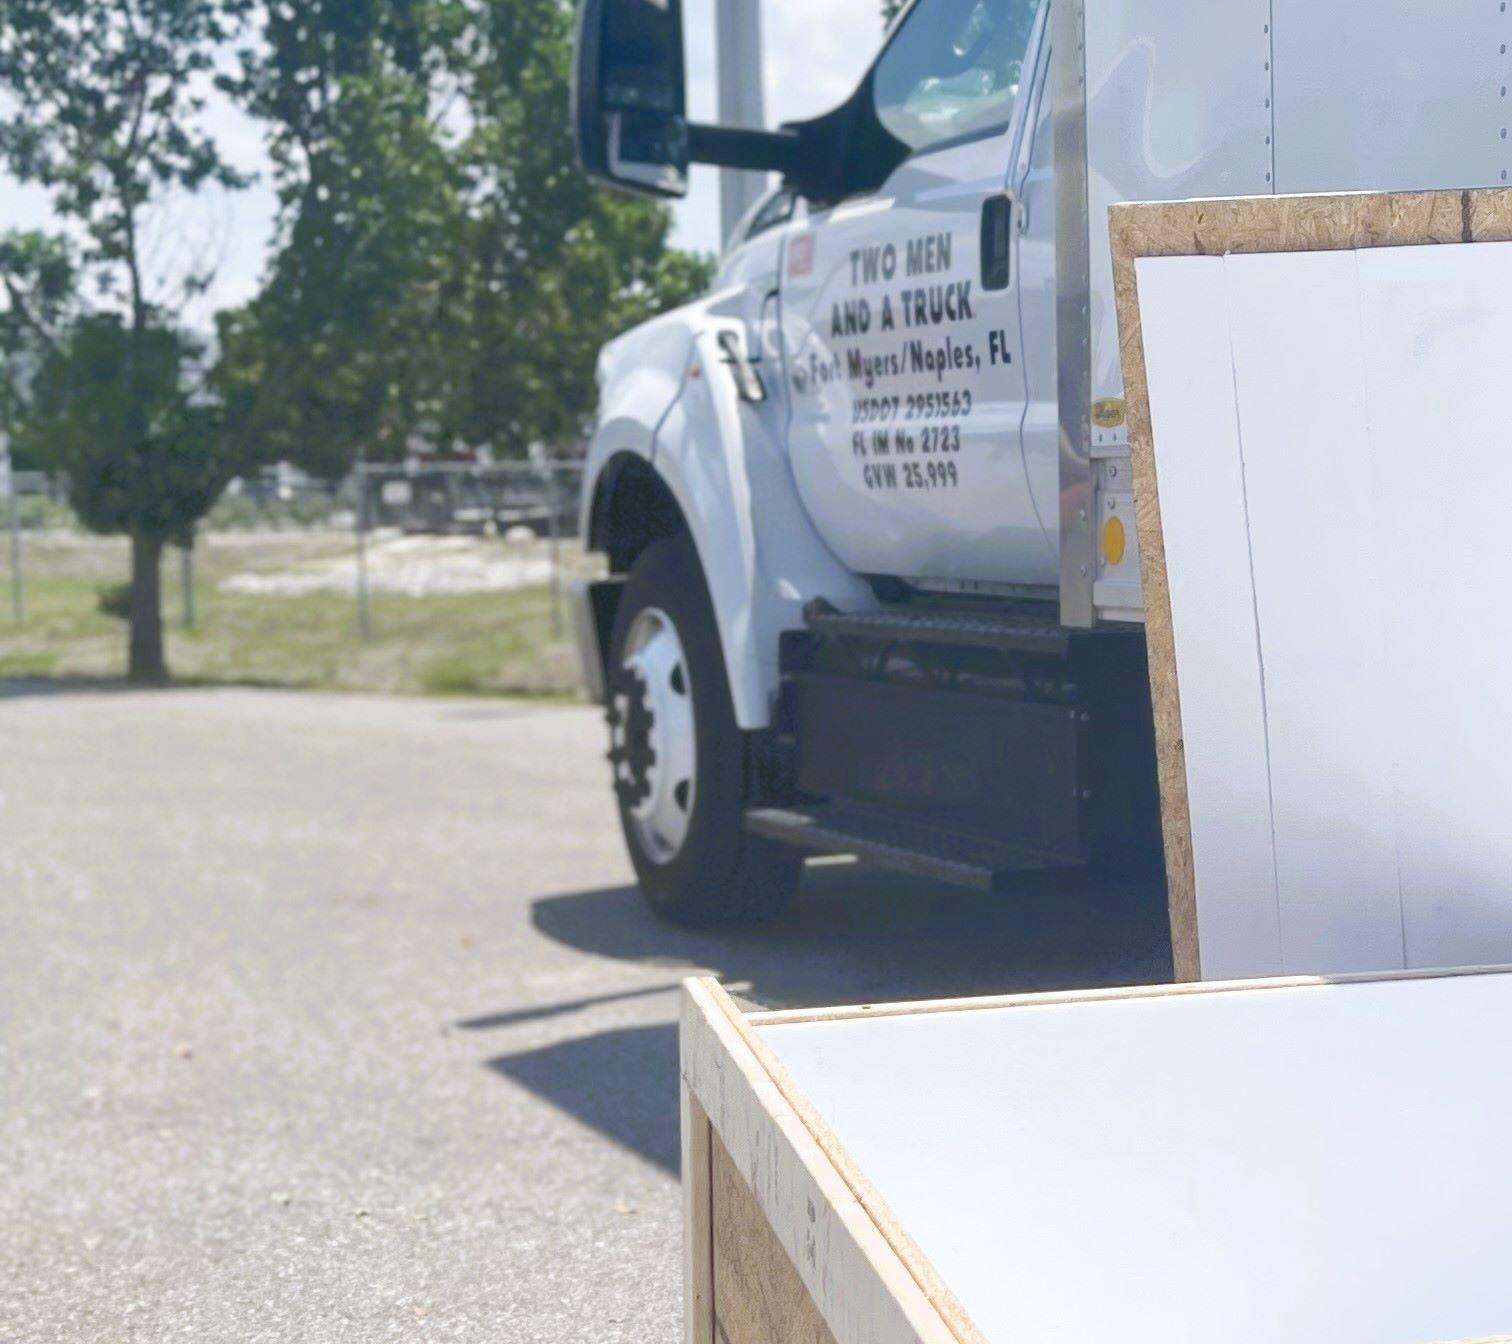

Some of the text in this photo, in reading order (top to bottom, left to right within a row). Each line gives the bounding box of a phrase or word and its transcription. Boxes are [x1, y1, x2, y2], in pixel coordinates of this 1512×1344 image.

[850, 231, 952, 287] TWO MEN
[831, 279, 973, 338] AND A TRUCK
[811, 346, 842, 385] Fort
[988, 328, 1011, 366] FL
[851, 389, 972, 424] USDOT 2951563
[852, 425, 960, 456] FL IM No 2723
[863, 460, 958, 491] GVW 25,999
